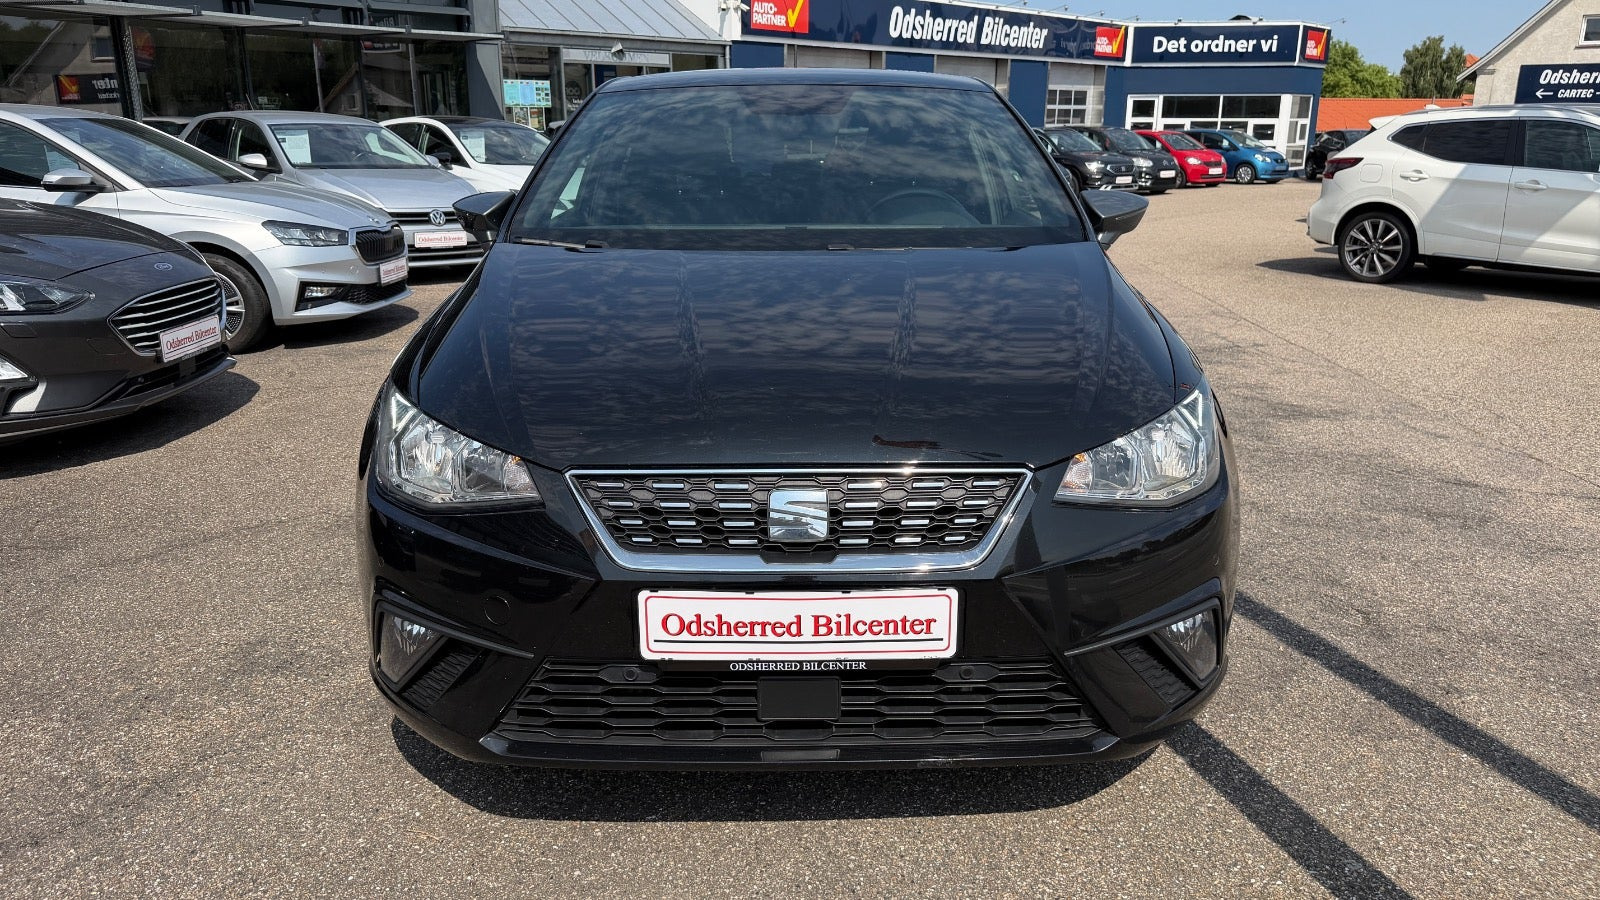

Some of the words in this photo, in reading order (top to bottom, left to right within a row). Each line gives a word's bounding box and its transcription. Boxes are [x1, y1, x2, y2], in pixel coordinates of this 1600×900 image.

[753, 2, 778, 14] AUTO-
[753, 14, 787, 26] PARTNER
[889, 5, 976, 42] Odsherred
[980, 16, 1049, 49] Bilcenter
[1153, 36, 1187, 53] Det
[1190, 35, 1257, 53] ordner
[1259, 35, 1279, 52] vi
[1557, 89, 1595, 98] CARTEC
[166, 331, 195, 351] Odsherred
[660, 612, 803, 637] Odsherred
[811, 613, 938, 637] Bilcenter
[729, 662, 800, 671] ODSHERRED
[802, 661, 867, 671] BILCENTER
